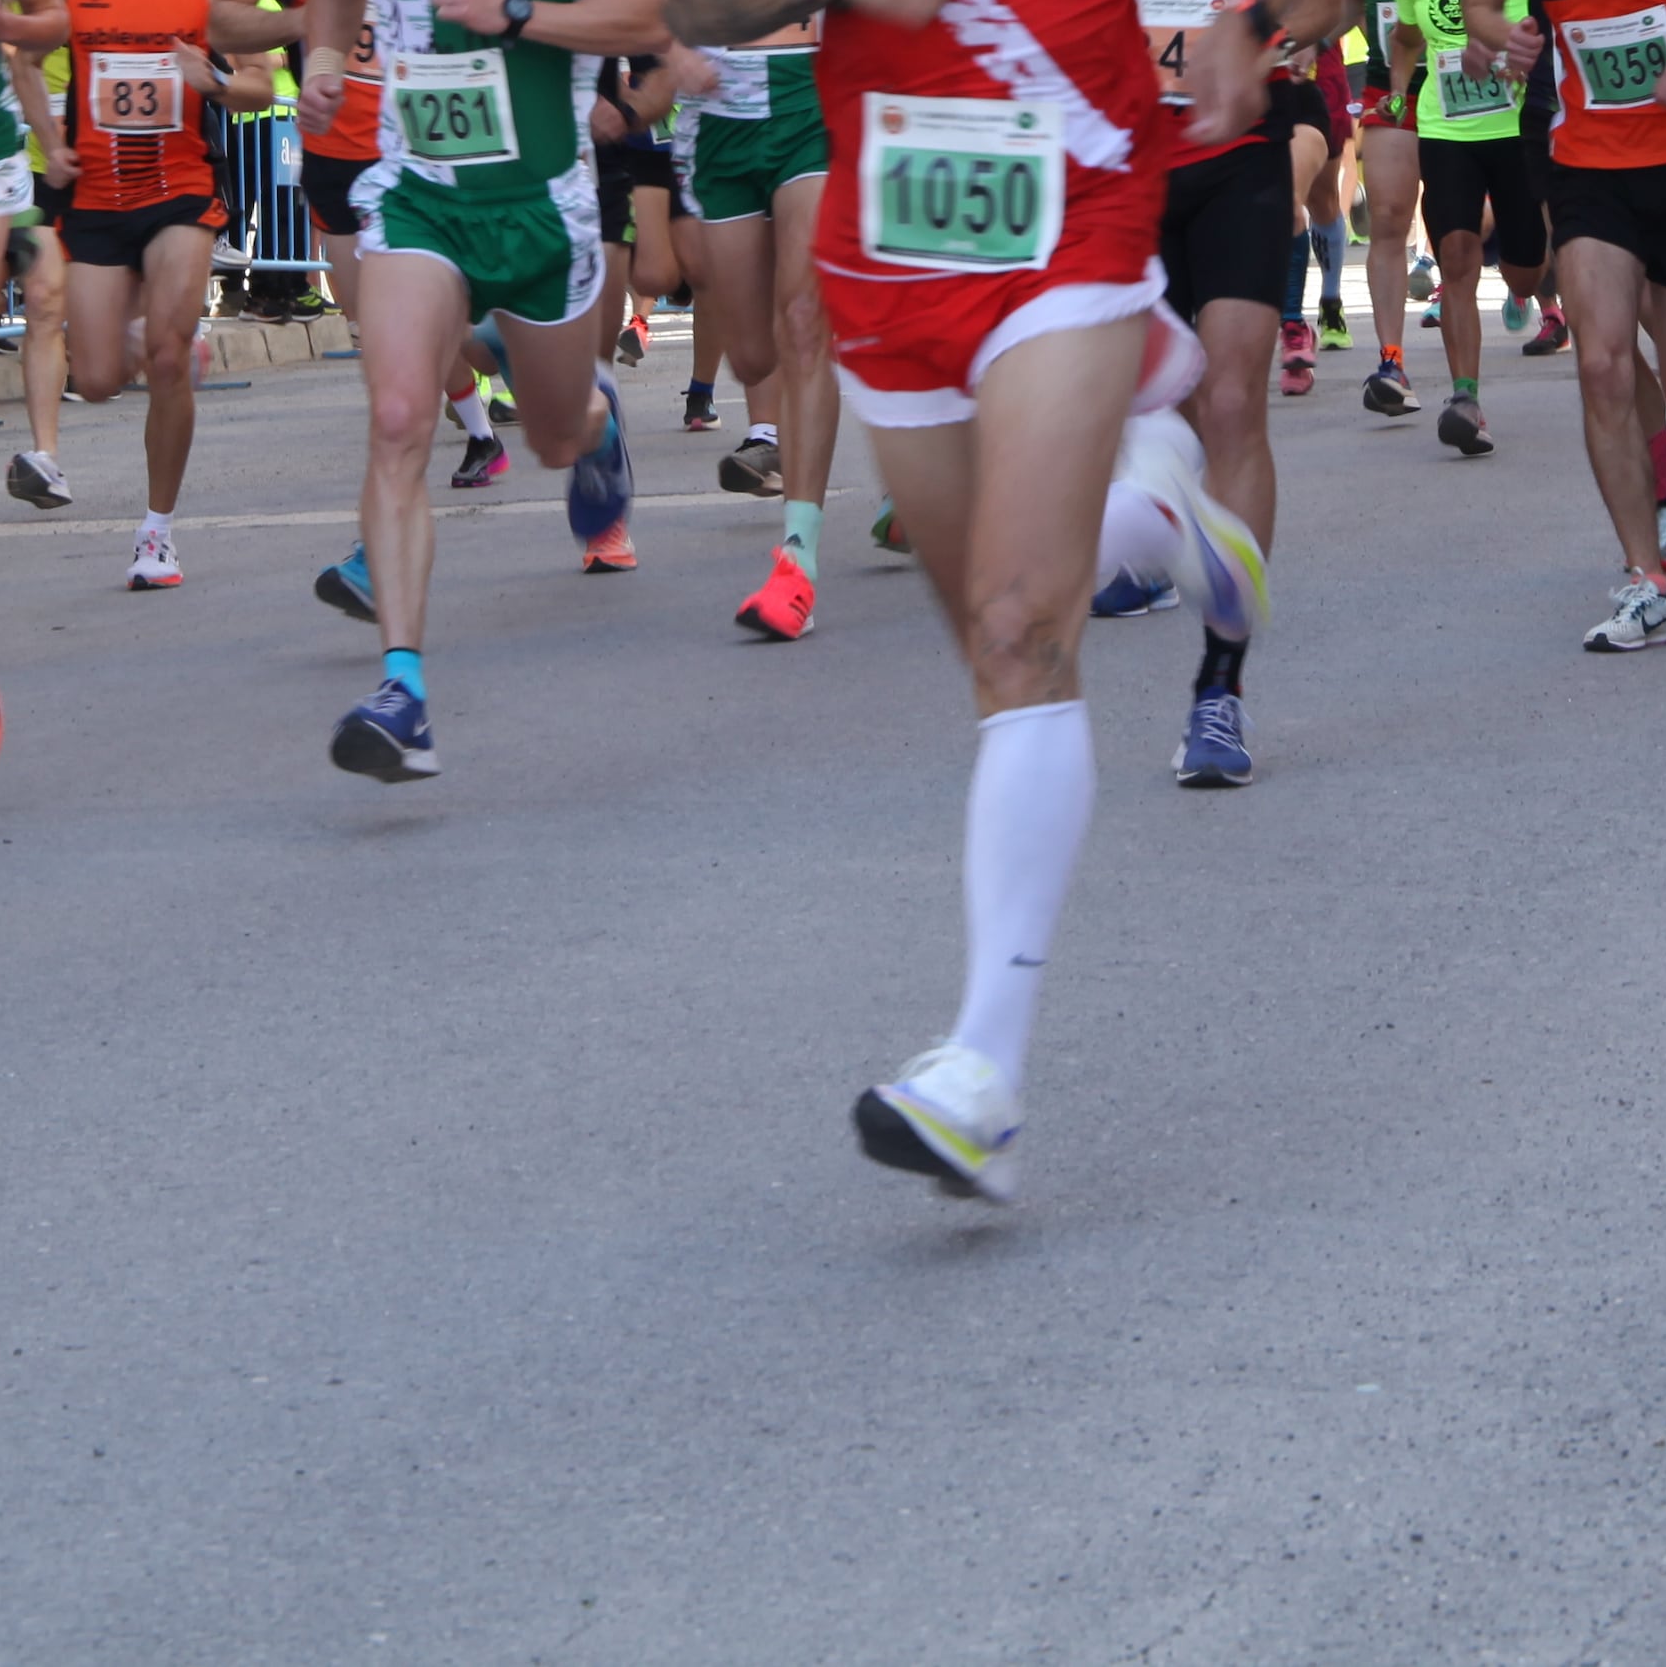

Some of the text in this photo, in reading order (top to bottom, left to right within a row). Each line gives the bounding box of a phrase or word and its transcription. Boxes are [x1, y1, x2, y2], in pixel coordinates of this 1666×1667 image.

[1587, 41, 1666, 90] 1359
[113, 80, 158, 117] 83
[400, 90, 494, 141] 1261
[885, 153, 1039, 236] 1050
